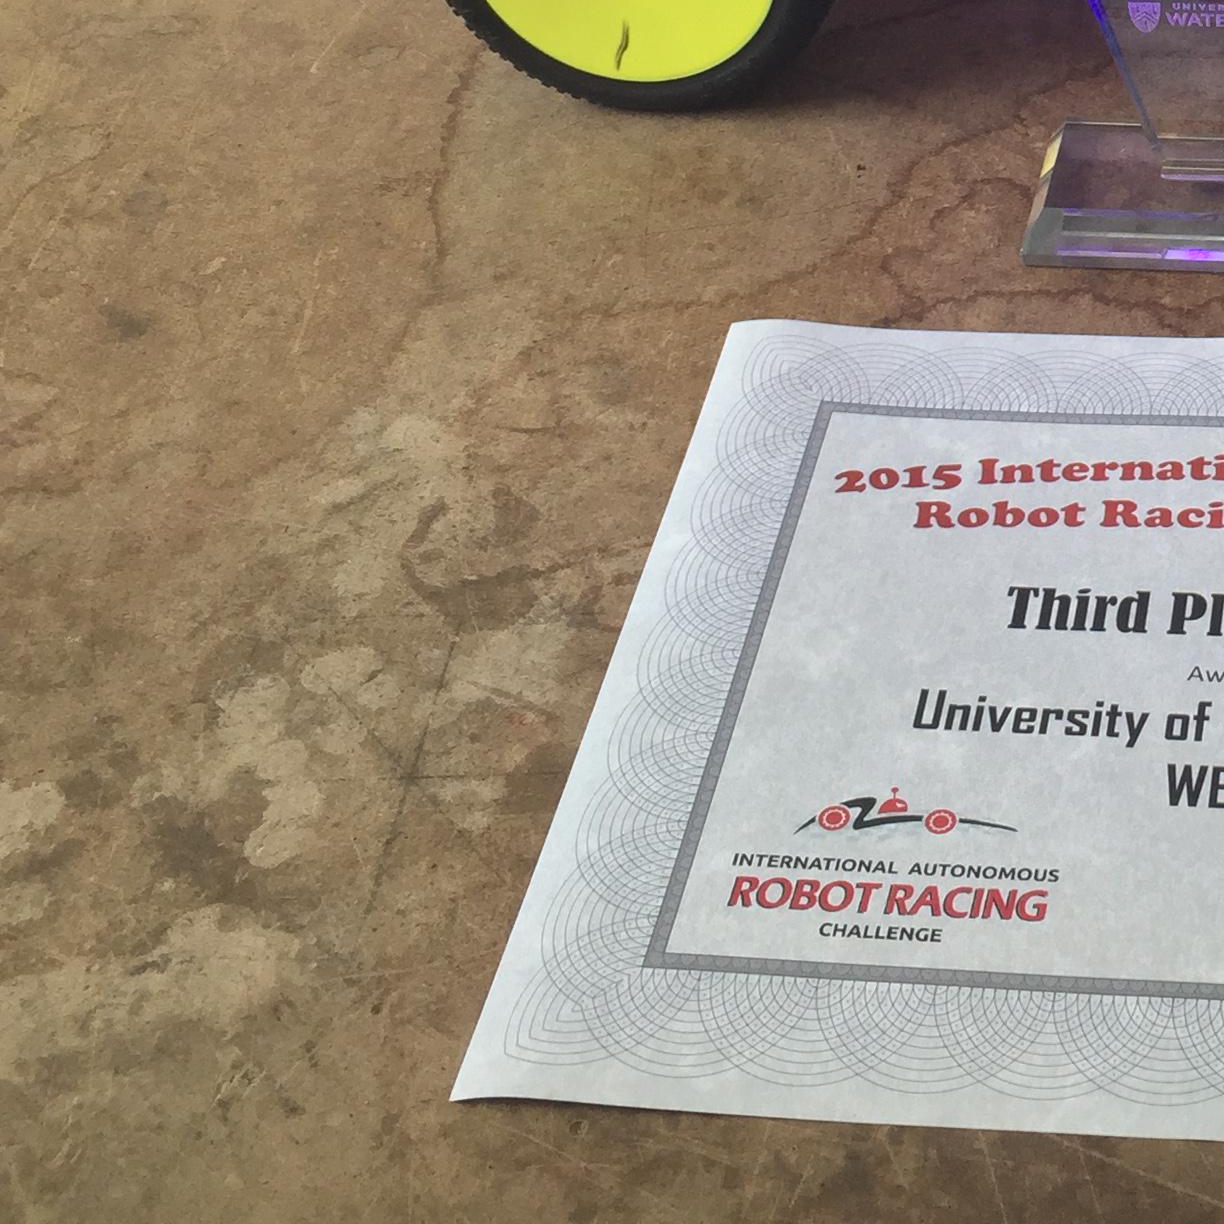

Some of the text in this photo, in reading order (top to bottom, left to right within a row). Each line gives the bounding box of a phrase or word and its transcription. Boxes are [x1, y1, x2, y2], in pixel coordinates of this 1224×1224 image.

[834, 462, 964, 494] 2015
[913, 499, 1087, 529] Robot
[1007, 585, 1151, 634] Third
[912, 688, 1150, 749] University
[1164, 700, 1213, 742] of
[731, 852, 1060, 883] INTERNATIONAL AUTONOMOUS
[727, 875, 1049, 923] ROBOT RACING
[818, 922, 943, 944] CHALLENGE
